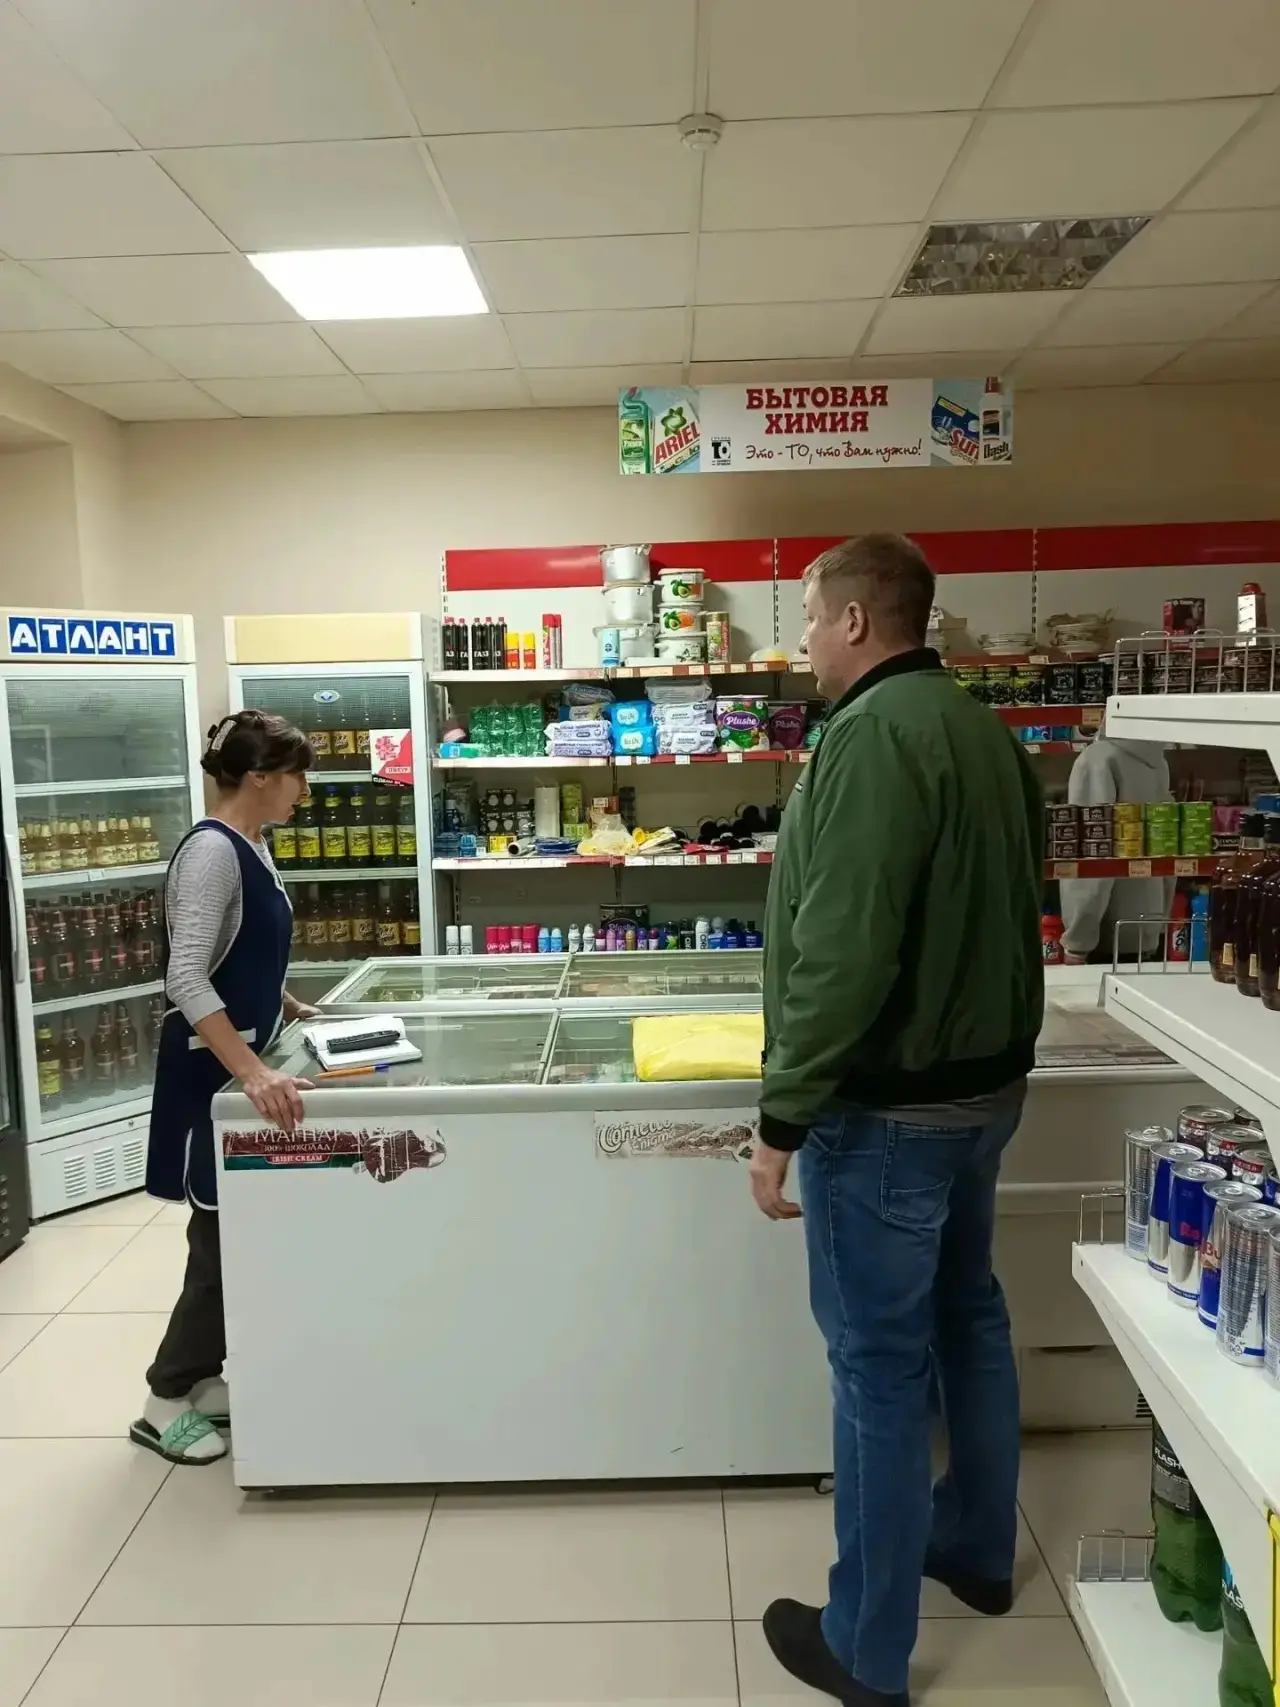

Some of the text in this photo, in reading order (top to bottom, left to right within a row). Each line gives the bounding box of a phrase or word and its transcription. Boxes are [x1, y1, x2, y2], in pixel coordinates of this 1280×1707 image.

[746, 385, 888, 409] БЫТОВАЯ
[765, 411, 869, 434] ХИМИЯ
[655, 421, 701, 464] ARIEL
[745, 444, 774, 460] Это
[815, 446, 840, 458] что
[842, 440, 873, 458] Вам
[875, 438, 922, 463] нужно!
[12, 623, 171, 651] АТЛАНТ
[725, 715, 757, 726] Plushe
[1221, 1578, 1244, 1609] FLAS
